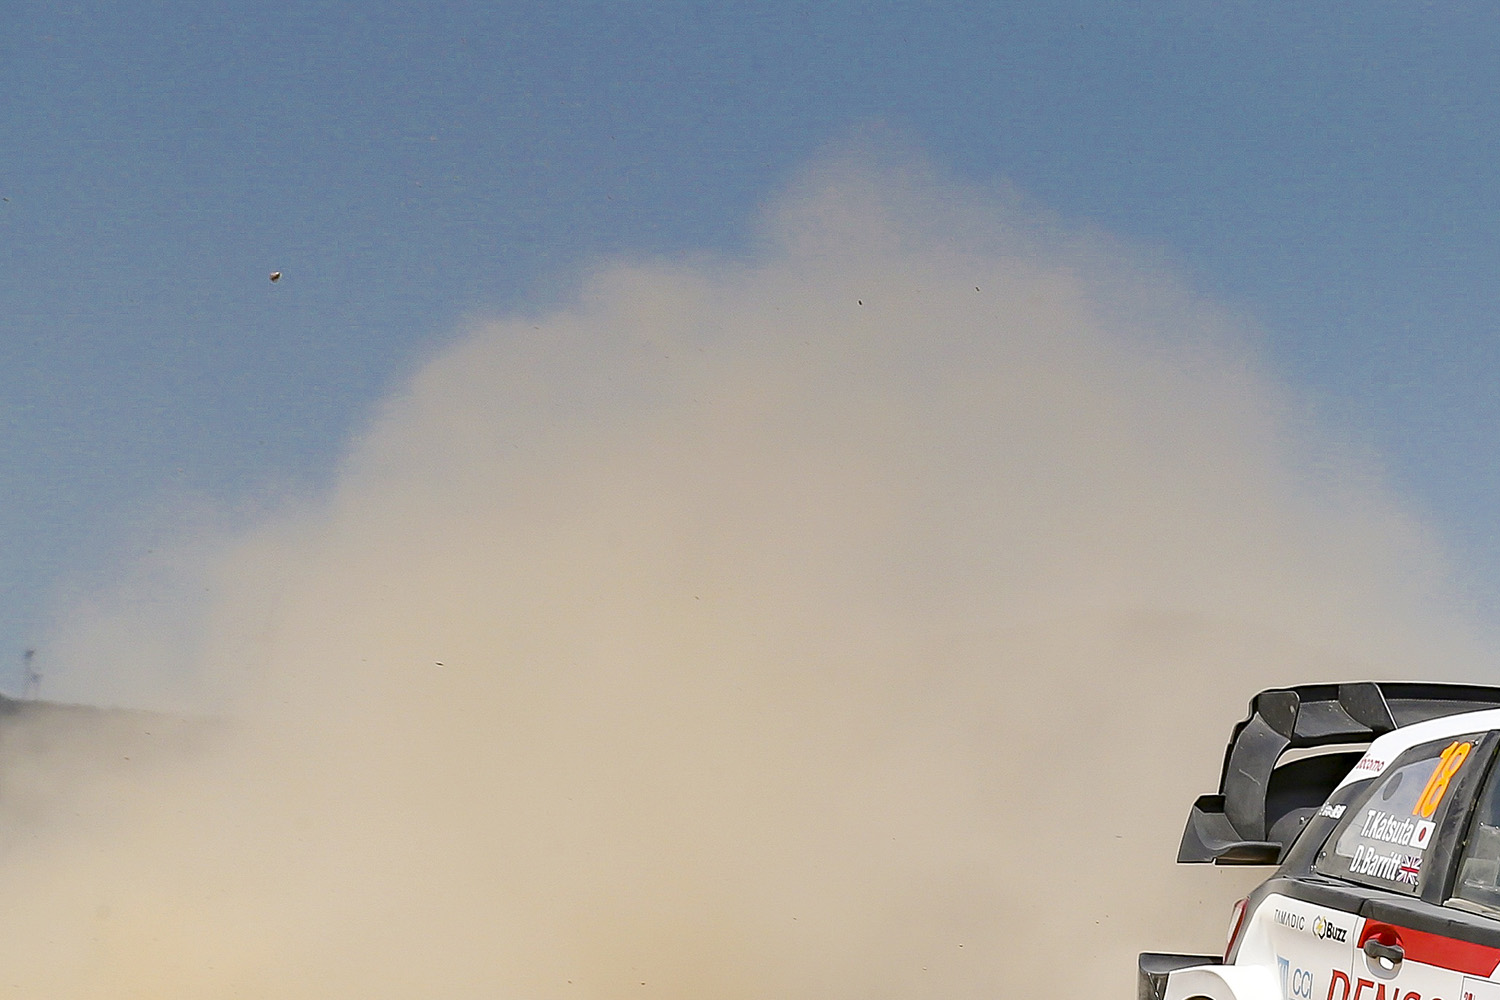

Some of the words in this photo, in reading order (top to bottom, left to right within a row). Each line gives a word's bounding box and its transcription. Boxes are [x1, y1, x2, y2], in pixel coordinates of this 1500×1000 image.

[1412, 741, 1471, 818] 18
[1361, 809, 1415, 846] T.Katsuta
[1349, 844, 1403, 881] D.Barritt
[1275, 909, 1305, 931] TAMADIC
[1293, 968, 1313, 999] CCI
